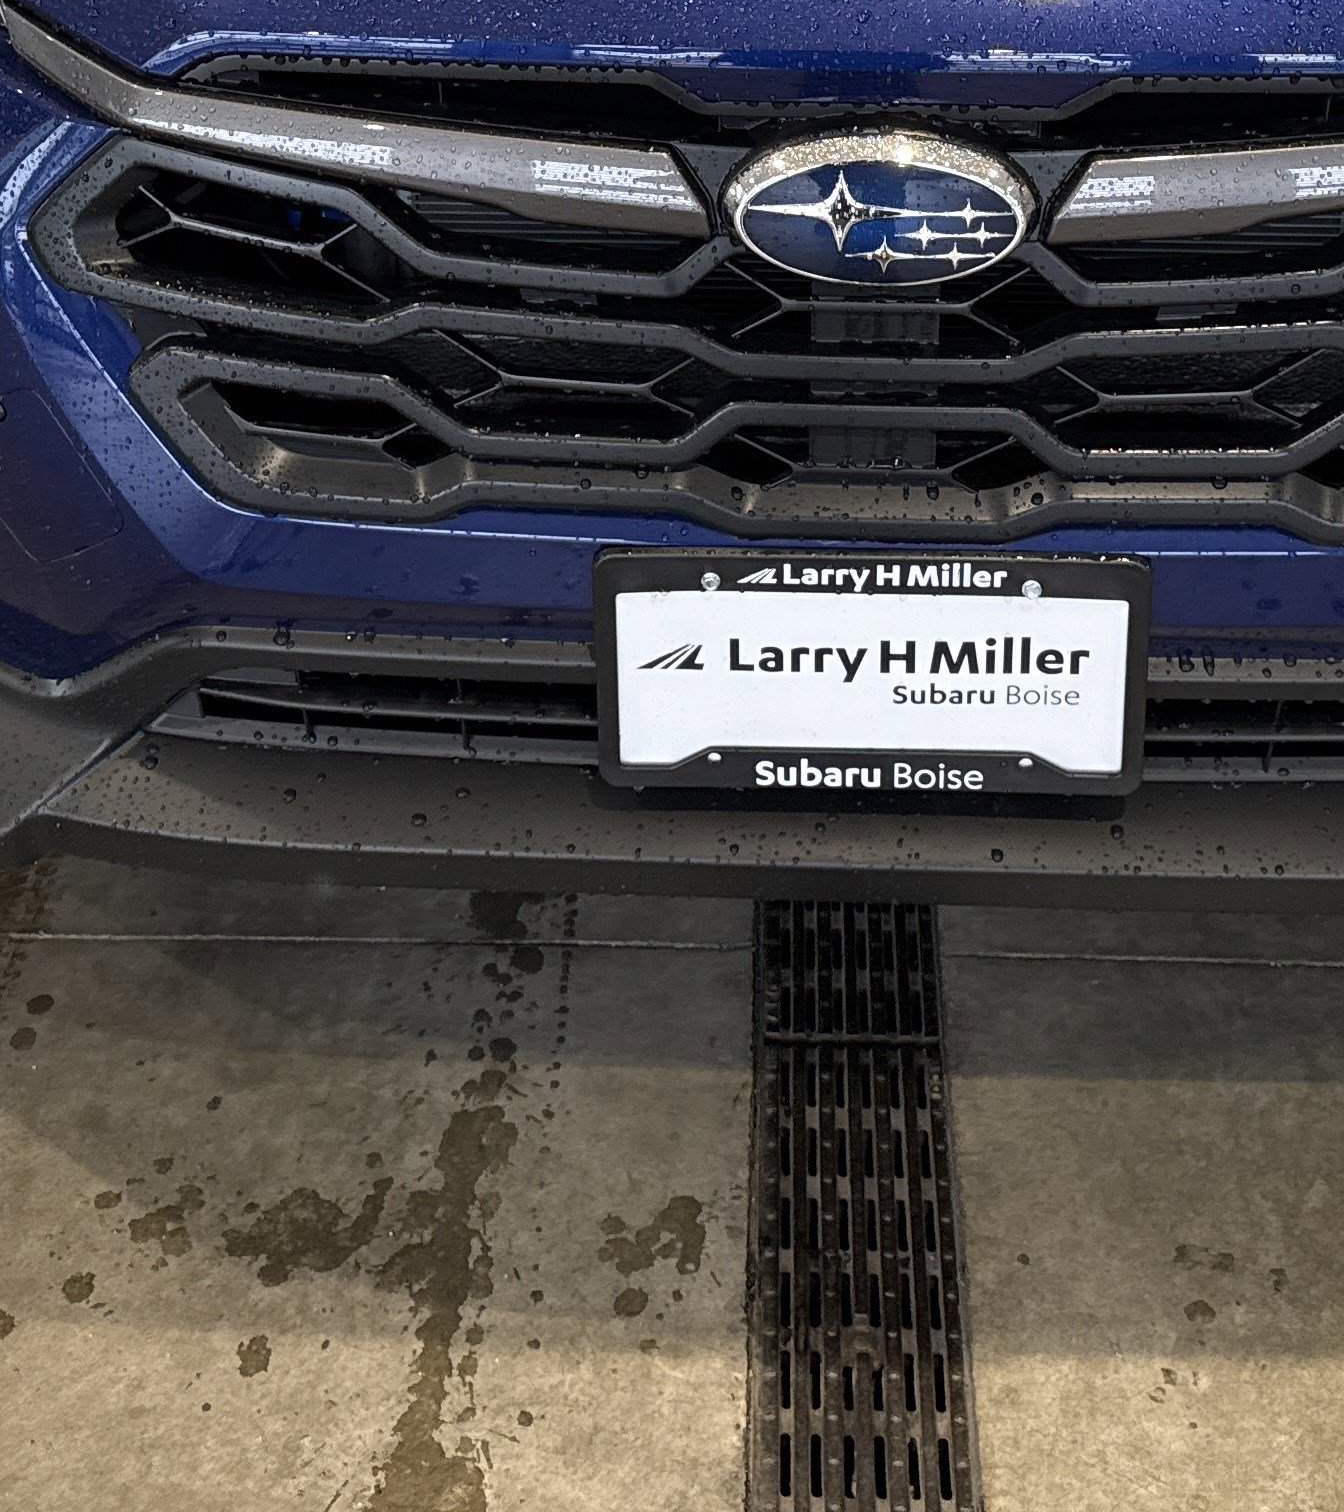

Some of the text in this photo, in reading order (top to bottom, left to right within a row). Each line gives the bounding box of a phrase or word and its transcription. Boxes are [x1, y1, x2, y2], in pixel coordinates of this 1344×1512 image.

[783, 562, 1008, 592] Larry H Miller
[729, 636, 1090, 683] Larry H Miller
[892, 682, 1080, 706] Subaru Boise
[755, 758, 984, 790] Subaru Boise
